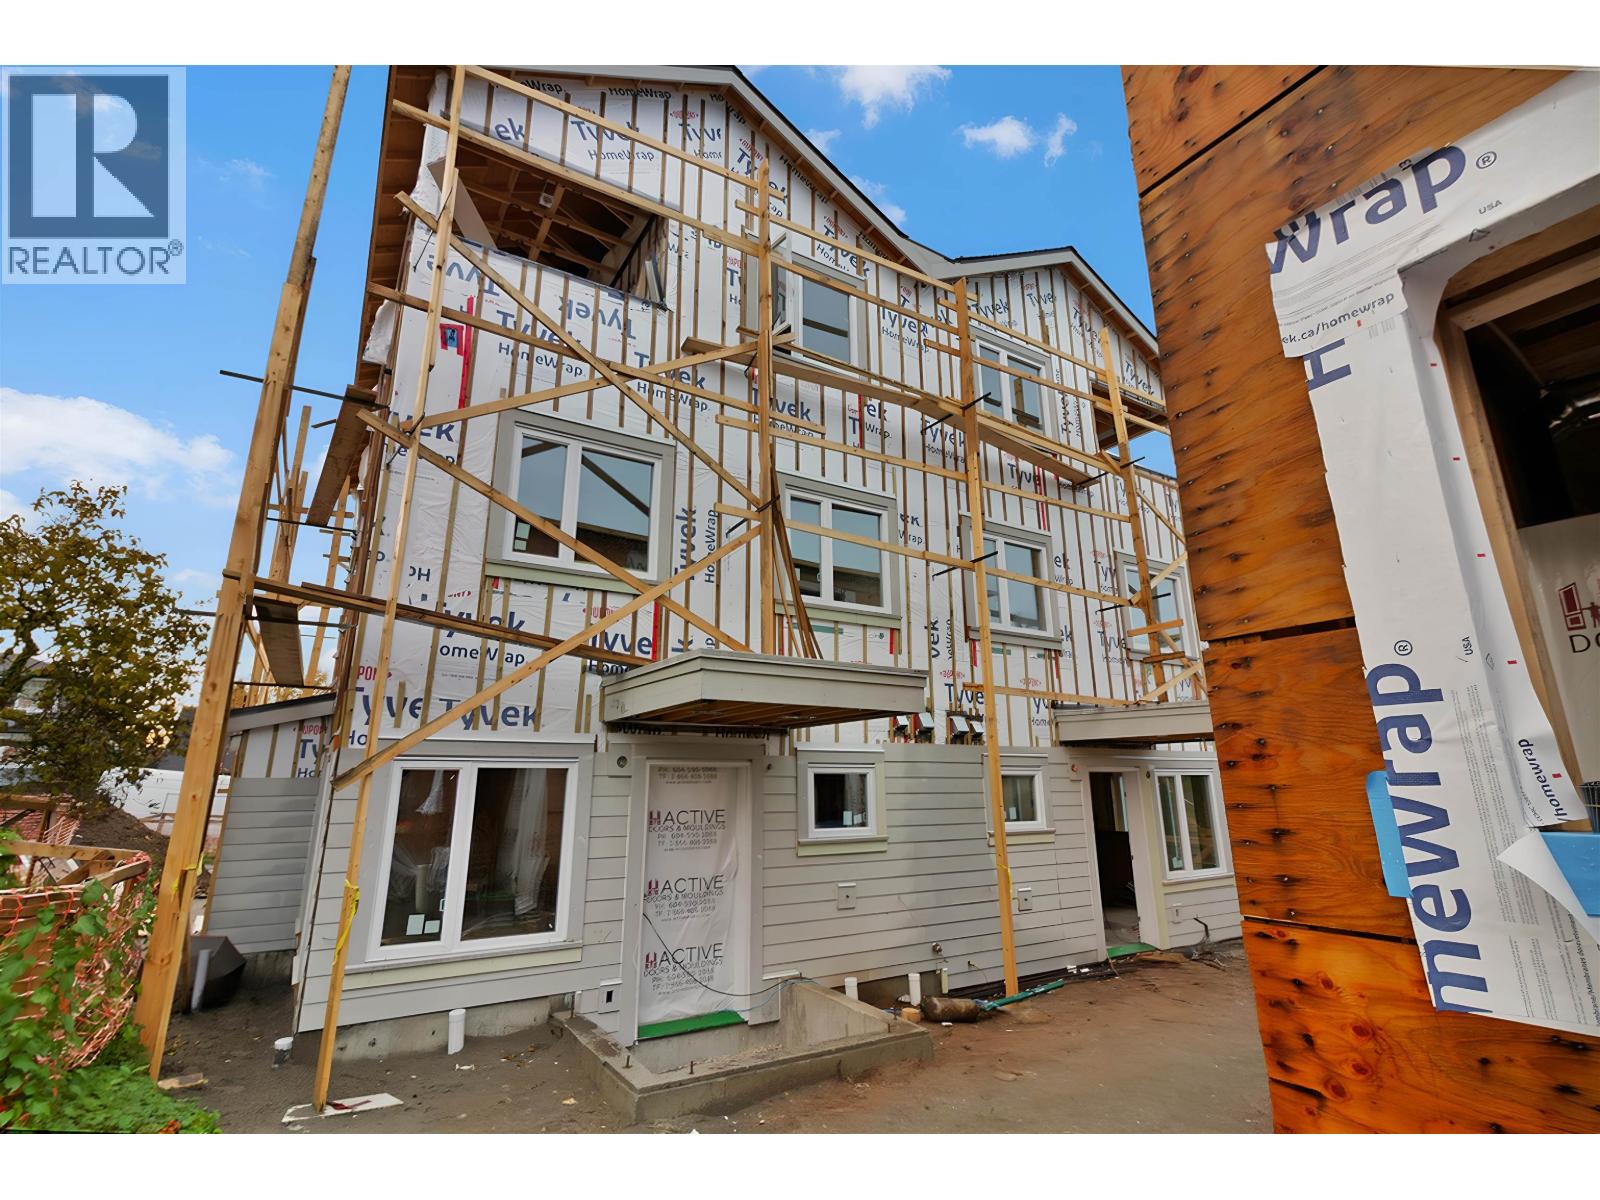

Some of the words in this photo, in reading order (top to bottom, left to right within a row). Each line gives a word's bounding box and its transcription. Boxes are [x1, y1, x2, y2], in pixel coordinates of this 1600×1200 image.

[1477, 200, 1503, 215] USA
[704, 509, 719, 584] HoeWrap
[944, 683, 984, 709] Tyve
